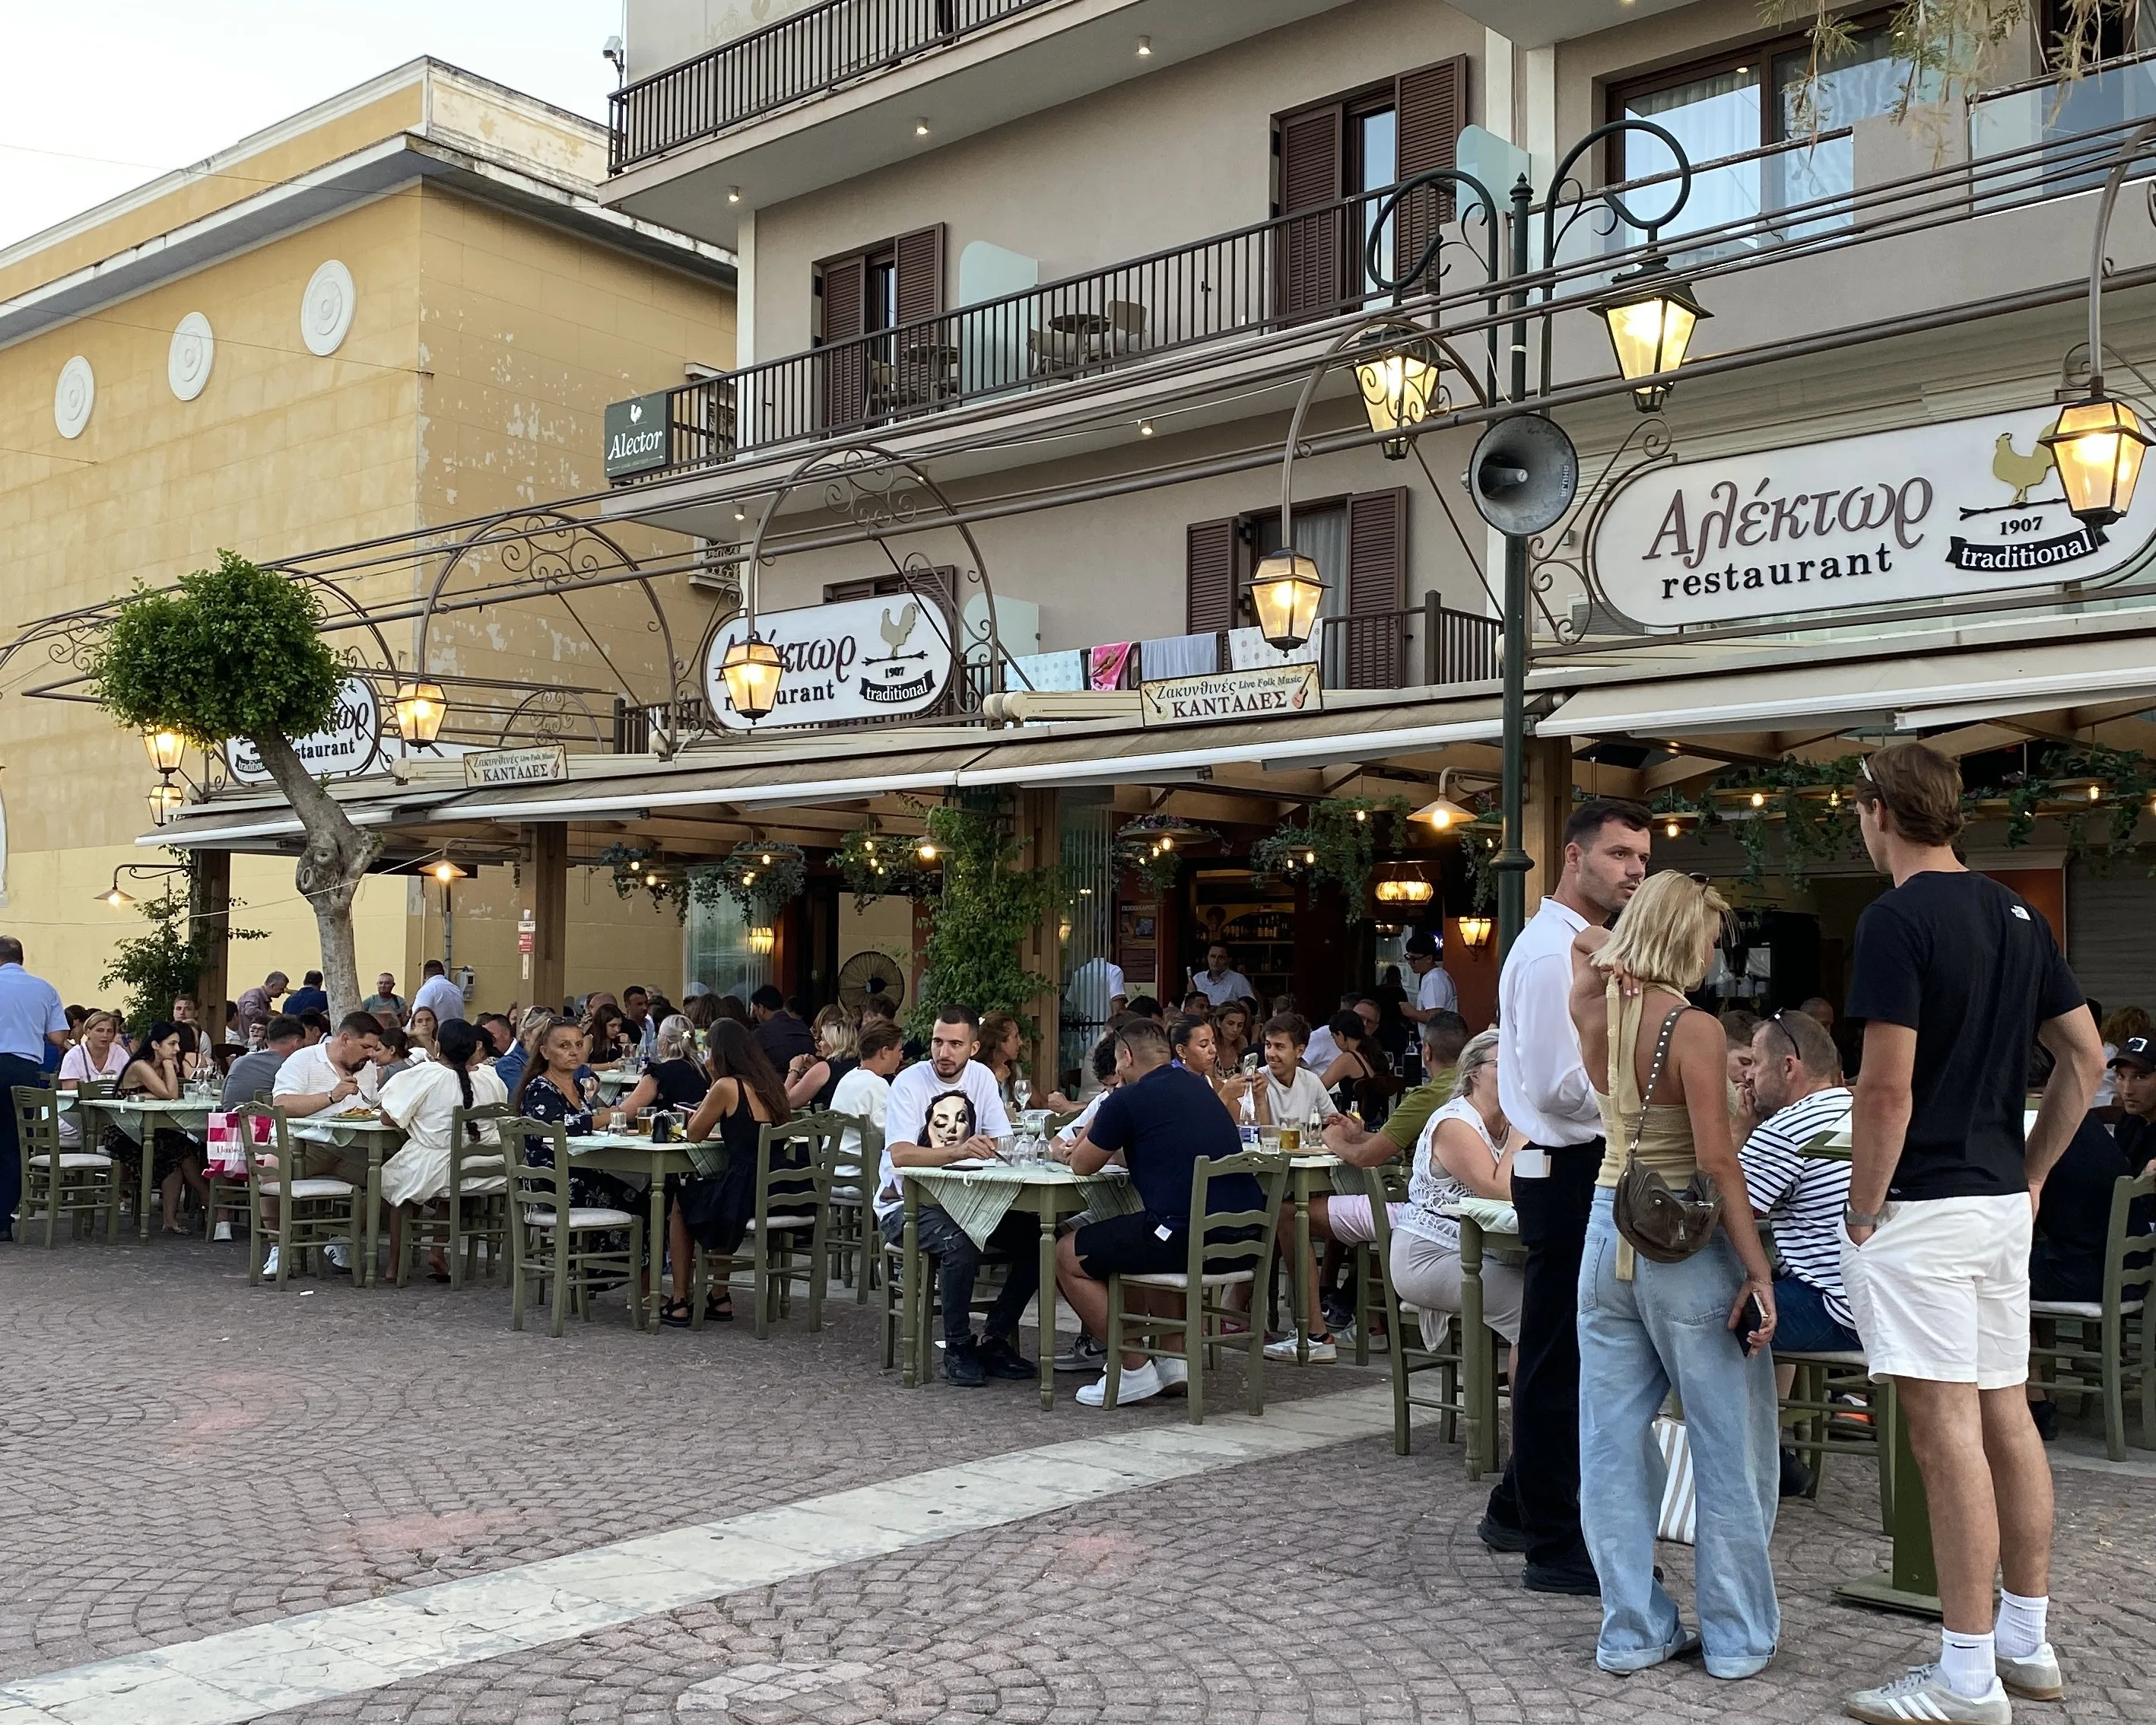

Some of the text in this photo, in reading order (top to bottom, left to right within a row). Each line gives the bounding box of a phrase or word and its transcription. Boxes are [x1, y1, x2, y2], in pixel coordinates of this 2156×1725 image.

[607, 430, 663, 461] Alector
[1560, 465, 1570, 497] AHUJA
[1641, 476, 1934, 569] Αλέκτωρ
[1999, 516, 2043, 535] 1907
[1960, 534, 2093, 570] traditional
[1661, 542, 1893, 599] restaurant
[884, 666, 905, 678] 1907
[1239, 675, 1302, 690] Live Folk Music
[866, 678, 929, 702] traditional
[1171, 691, 1288, 719] ΚΑΝΤΑΔΕΣ
[482, 764, 548, 782] ΚΑΝΤΑΔΕΣ
